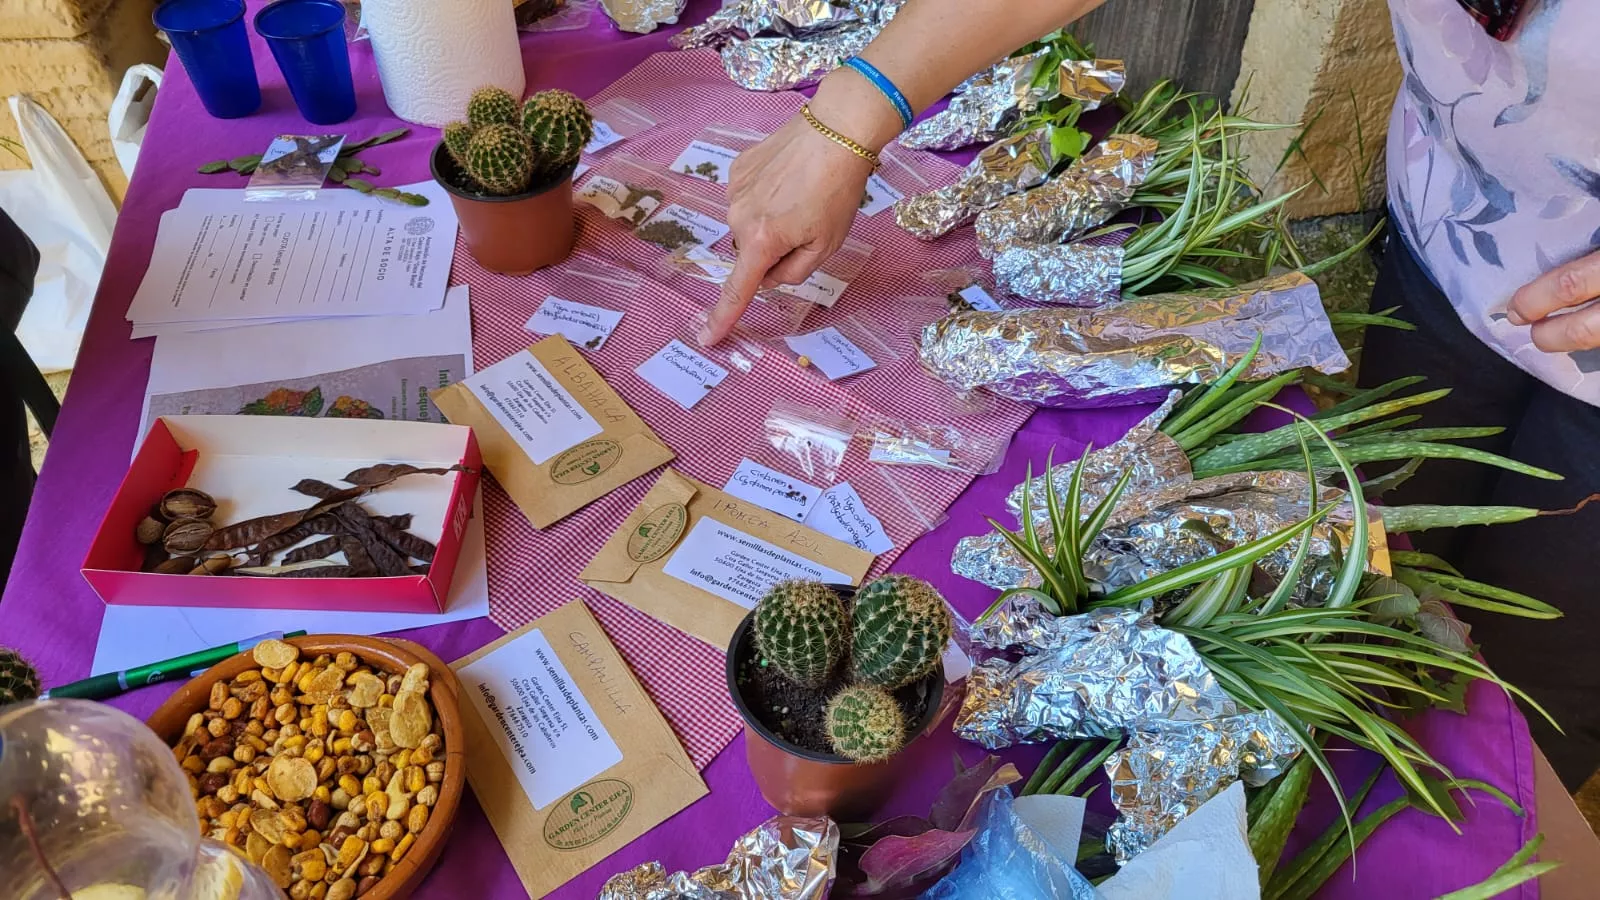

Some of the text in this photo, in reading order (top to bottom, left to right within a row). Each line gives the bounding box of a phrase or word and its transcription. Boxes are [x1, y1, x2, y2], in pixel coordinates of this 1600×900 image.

[281, 232, 291, 250] CUOTA
[376, 227, 397, 281] ALTA DE SOCIO
[416, 386, 431, 420] esquej
[525, 360, 583, 421] www.semillasdeplantas.com
[717, 530, 822, 577] www.semillasdeplantas.com
[730, 549, 750, 562] Garden
[750, 558, 770, 570] Center
[736, 573, 761, 587] Zaragoza
[509, 677, 525, 696] 50600
[568, 631, 628, 715] CAMPANILLA
[527, 689, 542, 706] Gallur
[529, 675, 546, 695] Garden
[541, 693, 557, 713] Center
[536, 648, 600, 742] www.semillasdeplantas.com
[515, 704, 534, 729] Zaragoza
[527, 705, 536, 715] de
[532, 713, 541, 723] los
[536, 721, 558, 749] Caballeros
[548, 786, 627, 840] GARDEN CENTER EJEA
